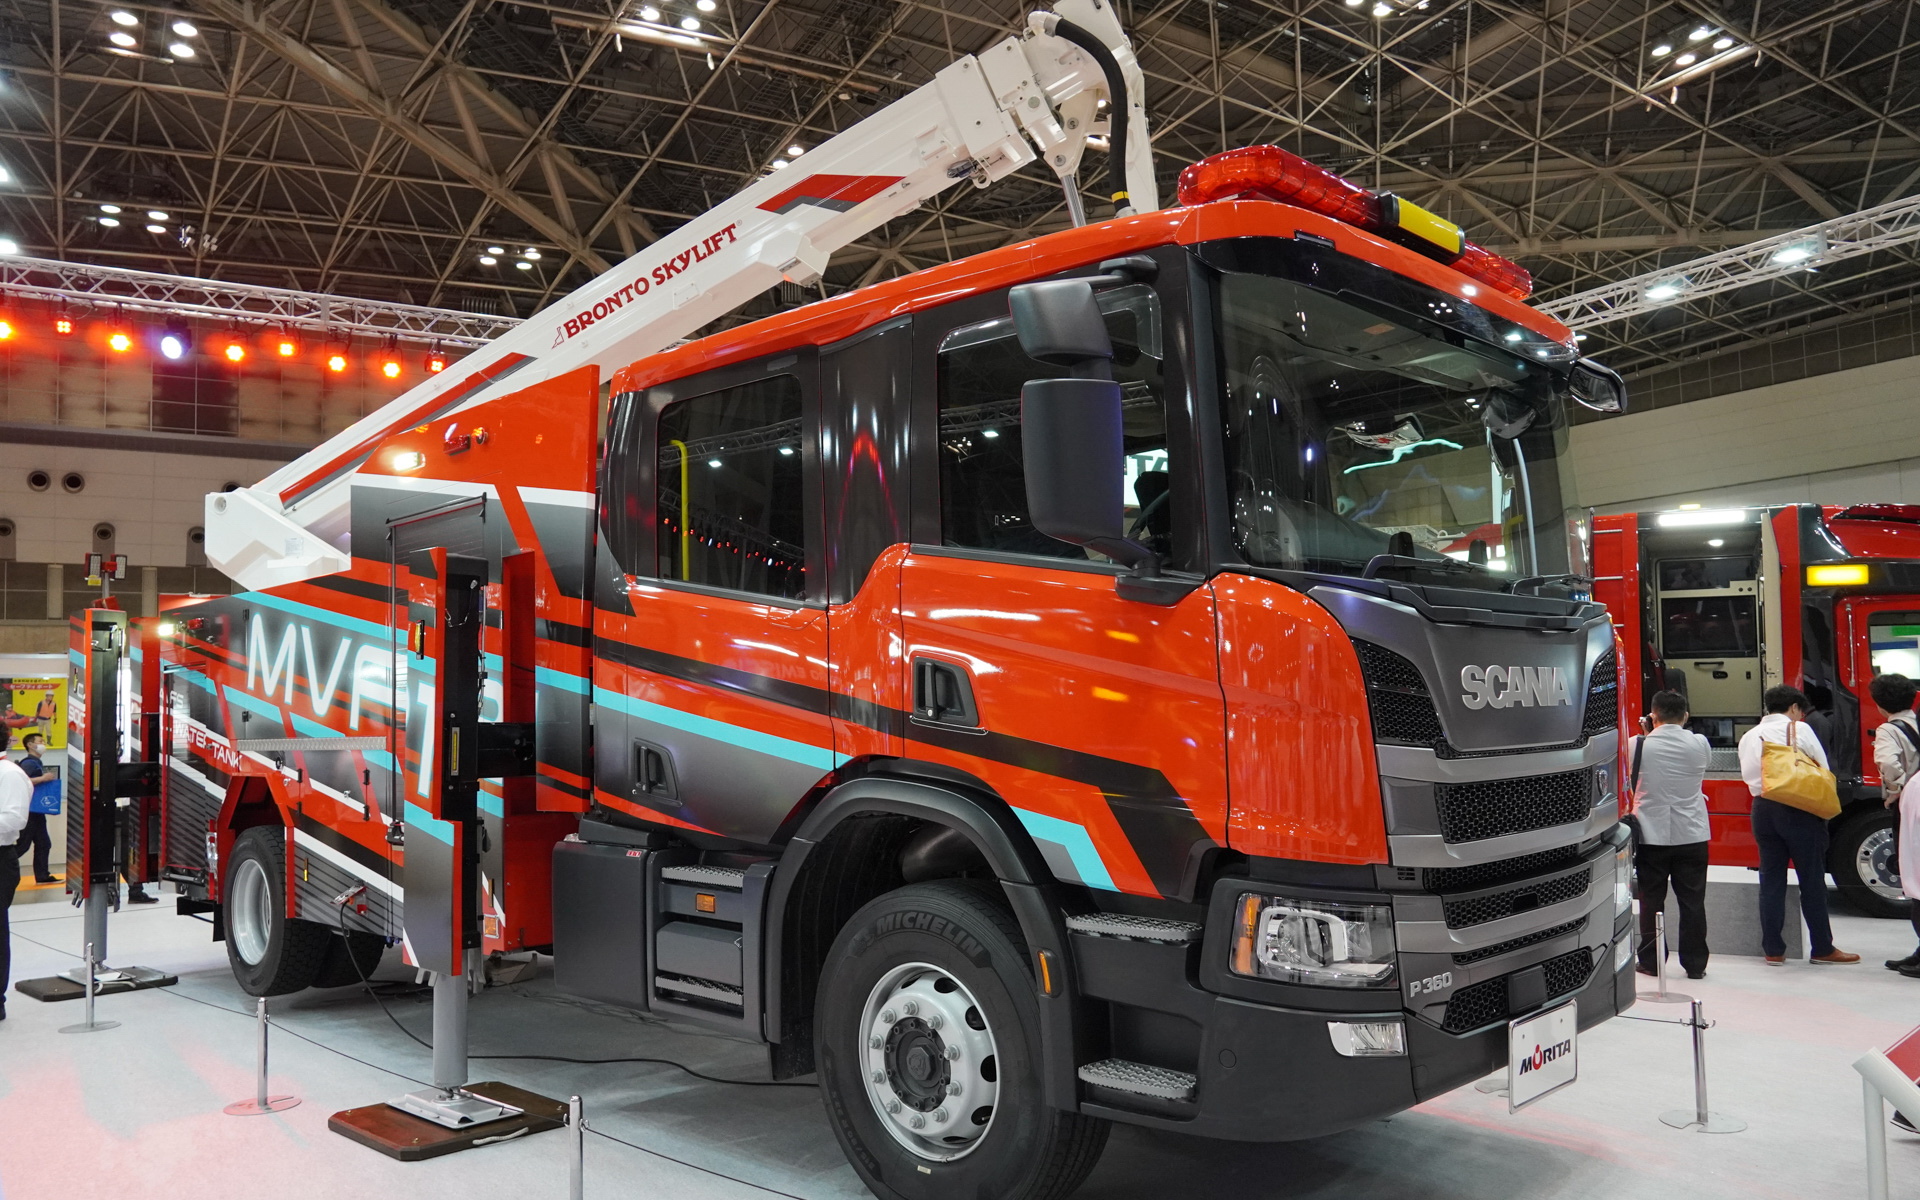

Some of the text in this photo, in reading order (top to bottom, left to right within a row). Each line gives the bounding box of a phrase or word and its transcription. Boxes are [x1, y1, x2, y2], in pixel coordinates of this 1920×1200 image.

[563, 222, 737, 338] BRONTO SKYLIFT
[1461, 664, 1573, 710] SCANIA
[211, 741, 242, 771] TANK
[876, 911, 984, 958] MICHELIN
[1410, 971, 1453, 998] P 360
[1519, 1038, 1571, 1076] MORITA
